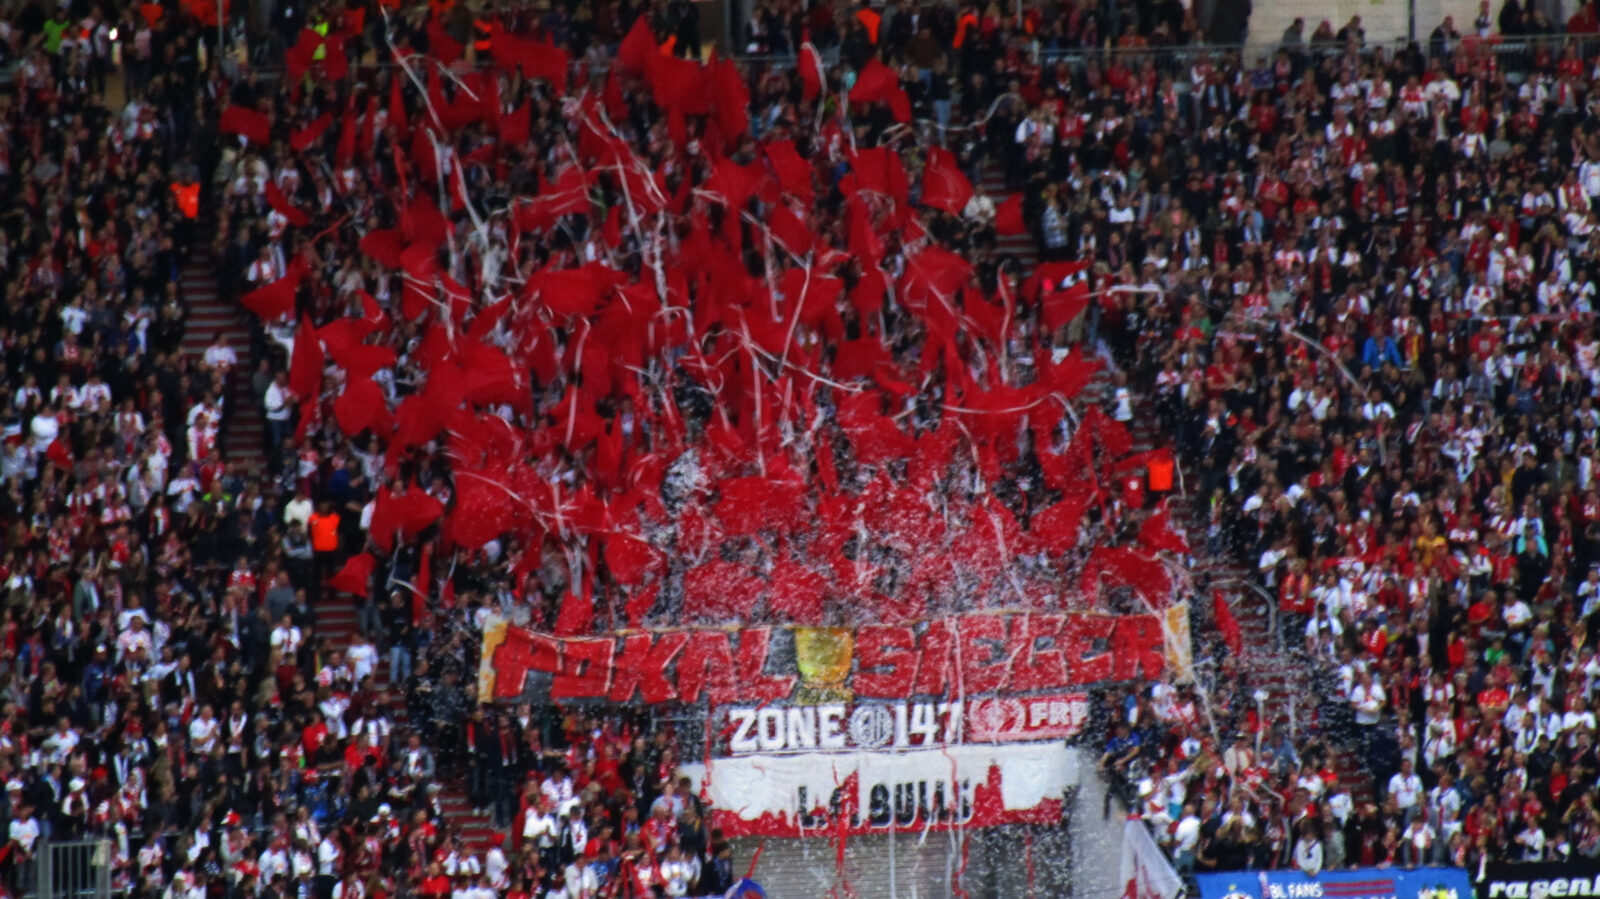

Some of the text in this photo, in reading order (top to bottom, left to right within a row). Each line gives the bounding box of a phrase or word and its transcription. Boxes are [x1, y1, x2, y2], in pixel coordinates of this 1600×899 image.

[493, 613, 1166, 704] POKAL SIEGER
[729, 703, 846, 750] ZONE
[896, 701, 963, 747] 147
[1030, 701, 1088, 728] FRP
